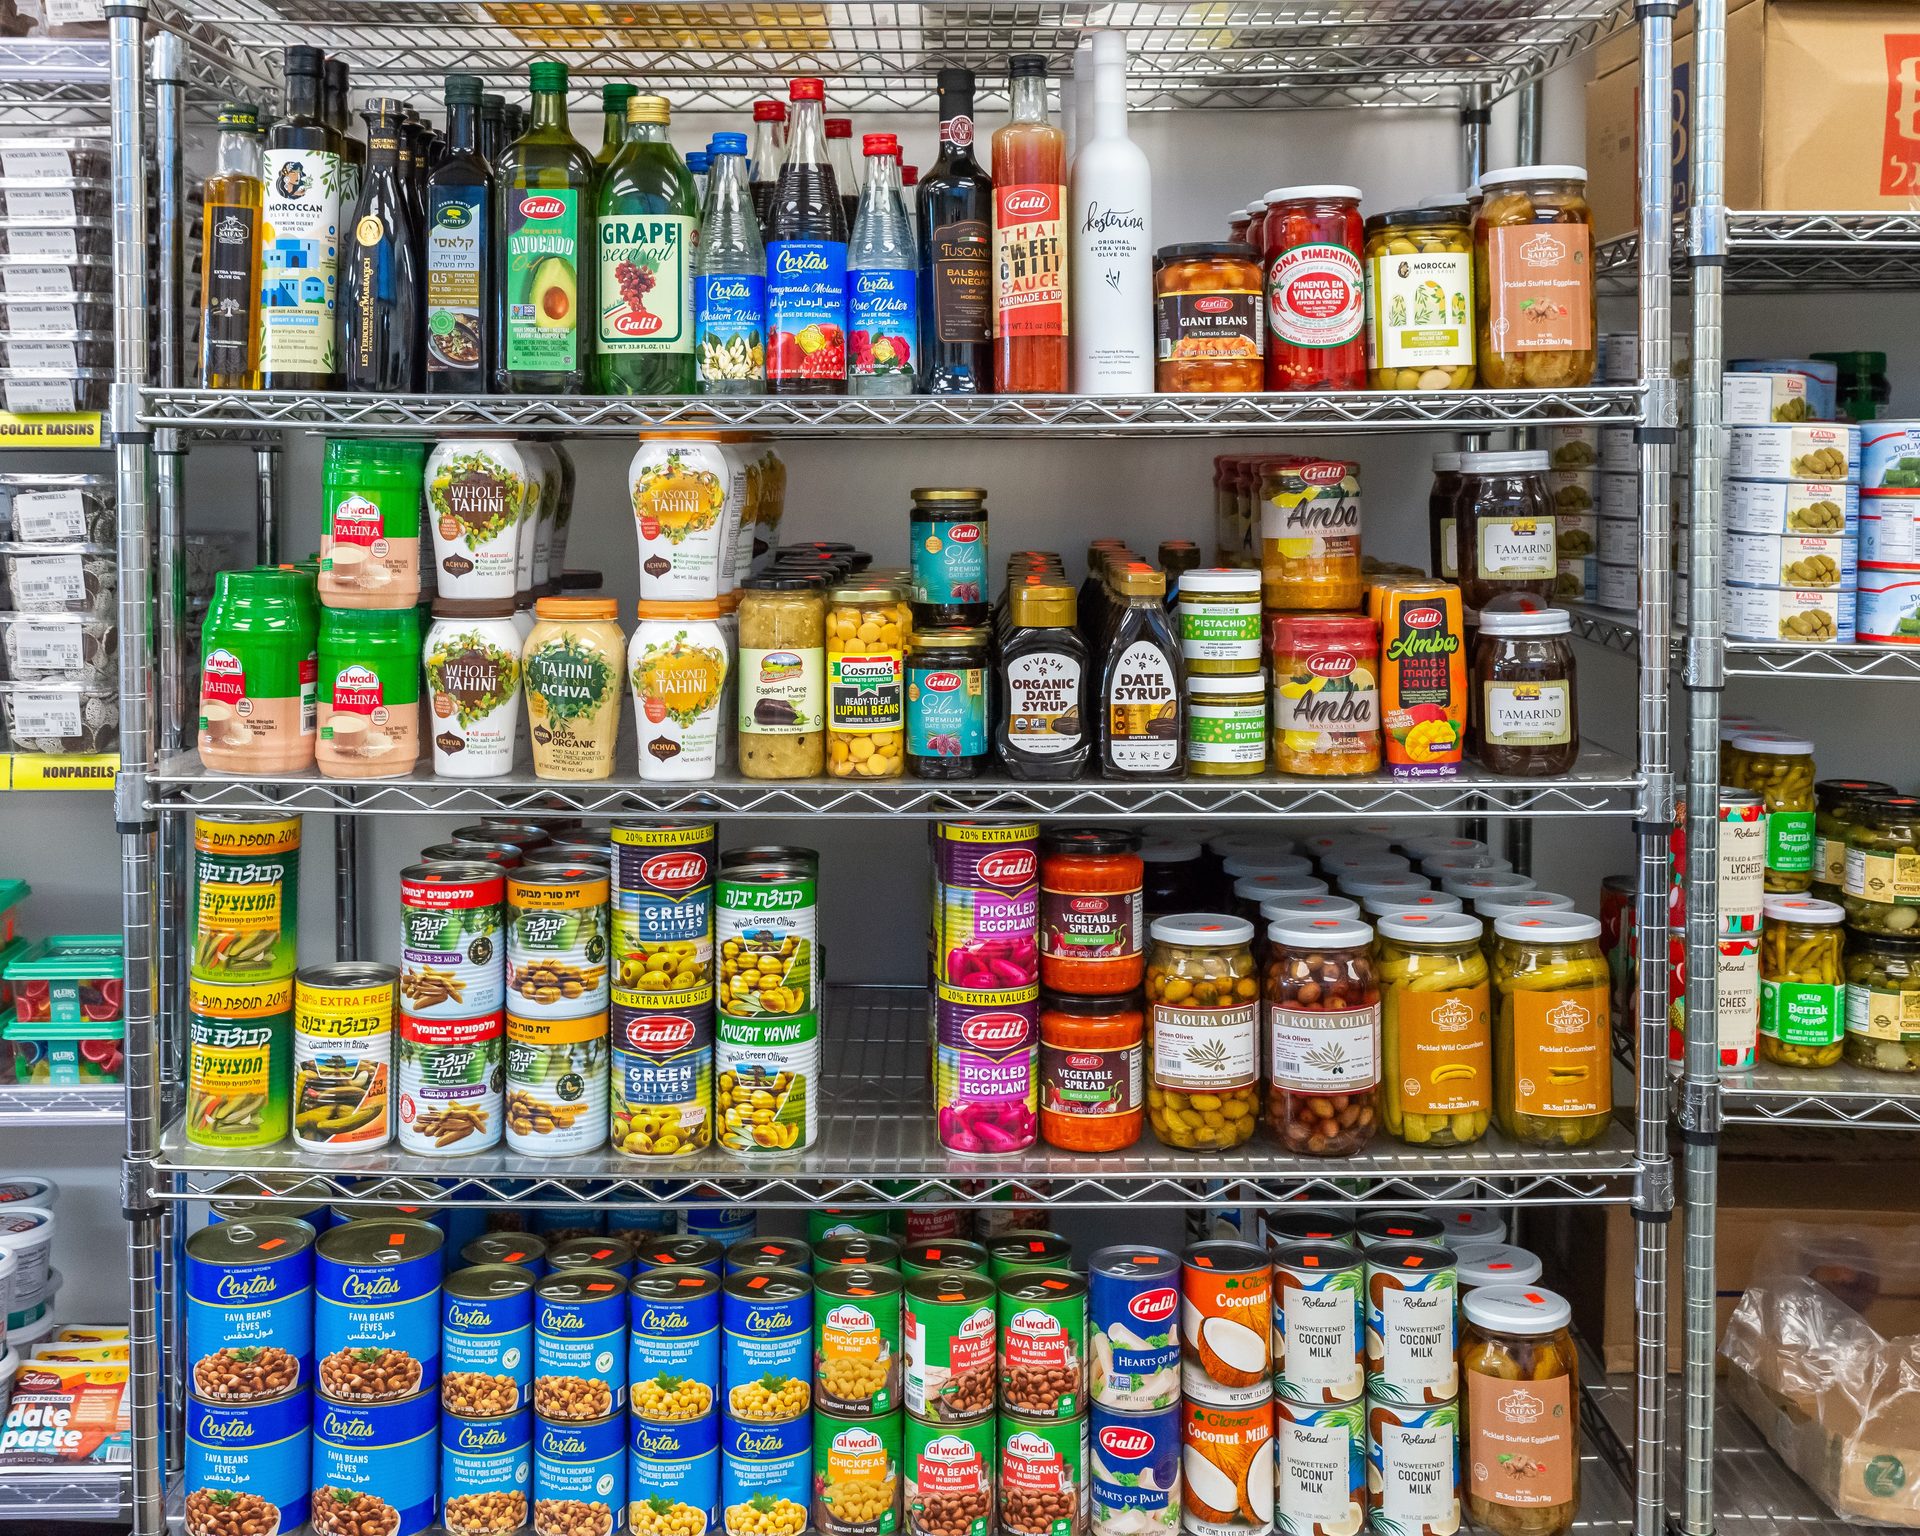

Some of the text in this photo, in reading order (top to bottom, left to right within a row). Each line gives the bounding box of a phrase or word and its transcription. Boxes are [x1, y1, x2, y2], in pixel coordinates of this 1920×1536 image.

[268, 203, 323, 213] MOROCCAN
[523, 201, 560, 215] Galil
[1081, 200, 1145, 235] kosterina
[603, 223, 677, 245] GRAPE
[1001, 223, 1056, 245] THAI
[433, 236, 474, 252] קלאסי
[510, 235, 574, 256] AVOCADO
[602, 237, 677, 264] seed oil
[432, 261, 475, 269] כתית מעולה
[776, 250, 829, 274] Cortas
[1000, 255, 1060, 281] CHILI
[1271, 248, 1363, 281] DONA PIMENTINHA
[1413, 262, 1457, 270] MOROCCAN
[431, 273, 448, 284] 0.5
[1002, 273, 1059, 295] SAUCE
[1293, 280, 1344, 290] PIMENTA EM
[1527, 279, 1552, 287] Stuffed
[1552, 280, 1581, 289] Eggplants
[708, 281, 751, 300] Cortas
[1042, 291, 1049, 301] &
[1050, 289, 1062, 300] DIP
[1292, 288, 1345, 301] VINAGRE
[870, 297, 909, 312] Water
[615, 315, 661, 332] Galil
[1179, 316, 1248, 326] GIANT BEANS
[361, 354, 369, 367] LES
[45, 423, 94, 436] RAISINS
[451, 485, 504, 499] WHOLE
[650, 488, 700, 500] SEASONED
[451, 498, 504, 513] TAHINI
[651, 499, 700, 513] TAHINI
[1286, 497, 1359, 530] Amba
[335, 524, 380, 537] TAHINA
[1494, 543, 1552, 554] TAMARIND
[445, 561, 469, 569] ACHVA
[1194, 619, 1247, 628] PISTACHIO
[1203, 629, 1238, 638] BUTTER
[841, 661, 893, 677] Cosmo's
[1022, 657, 1064, 673] D'VASH
[1402, 658, 1447, 669] TANGY
[445, 676, 497, 692] TAHINI
[1011, 678, 1075, 690] ORGANIC
[1120, 674, 1164, 687] DATE
[204, 681, 243, 695] TAHINA
[540, 683, 592, 699] ACHVA
[756, 684, 807, 696] Eggplant Puree
[1114, 687, 1172, 700] SYRUP
[845, 696, 891, 705] READY-TO-EAT
[1025, 689, 1061, 701] DATE
[835, 702, 899, 716] LUPINI BEANS
[921, 694, 966, 716] Silan
[1021, 700, 1068, 712] SYRUP
[1498, 708, 1562, 720] TAMARIND
[552, 730, 576, 740] 100%
[552, 739, 596, 749] ORGANIC
[651, 743, 677, 752] ACHVA
[42, 766, 115, 779] NONPAREILS
[1734, 827, 1761, 839] Roland
[1779, 831, 1812, 843] Berrak
[1730, 862, 1761, 874] LYCHEES
[516, 887, 580, 901] זית סורי מבוקע
[644, 902, 705, 922] GREEN
[648, 916, 704, 932] OLIVES
[732, 916, 797, 929] Whole Green Olives
[978, 915, 1036, 933] EGGPLANT
[1062, 913, 1118, 925] VEGETABLE
[655, 928, 698, 941] PITTED
[1069, 923, 1111, 935] SPREAD
[320, 995, 360, 1008] EXTRA
[362, 991, 391, 1006] FREE
[615, 989, 708, 1006] 20% EXTRA VALUE SIZE
[1787, 1003, 1829, 1015] Berrak
[1158, 1030, 1194, 1041] Green Olives
[1276, 1032, 1312, 1043] Black Olives
[1416, 1044, 1440, 1052] Pickled
[1456, 1040, 1484, 1051] Cucumbers
[963, 1065, 1027, 1082] PICKLED
[963, 1079, 1027, 1096] EGGPLANT
[1215, 1289, 1267, 1308] Coconut
[1301, 1296, 1338, 1309] Roland
[224, 1309, 272, 1323] FAVA BEANS
[1294, 1324, 1346, 1333] UNSWEETENED
[672, 1338, 700, 1349] CHICKPEAS
[823, 1332, 878, 1346] CHICKPEAS
[1006, 1335, 1066, 1351] FAVA BEANS
[1299, 1333, 1342, 1346] COCONUT
[565, 1341, 595, 1352] CHICKPEAS
[639, 1347, 693, 1357] POIS CHICHES BOUILLIS
[1309, 1346, 1332, 1359] MILK
[1010, 1355, 1062, 1366] Foul Moudammas
[18, 1373, 61, 1388] Shams
[5, 1407, 72, 1429] date
[0, 1426, 83, 1452] paste
[1188, 1422, 1269, 1445] Coconut Milk
[1092, 1482, 1164, 1505] HEARTS OF PALM
